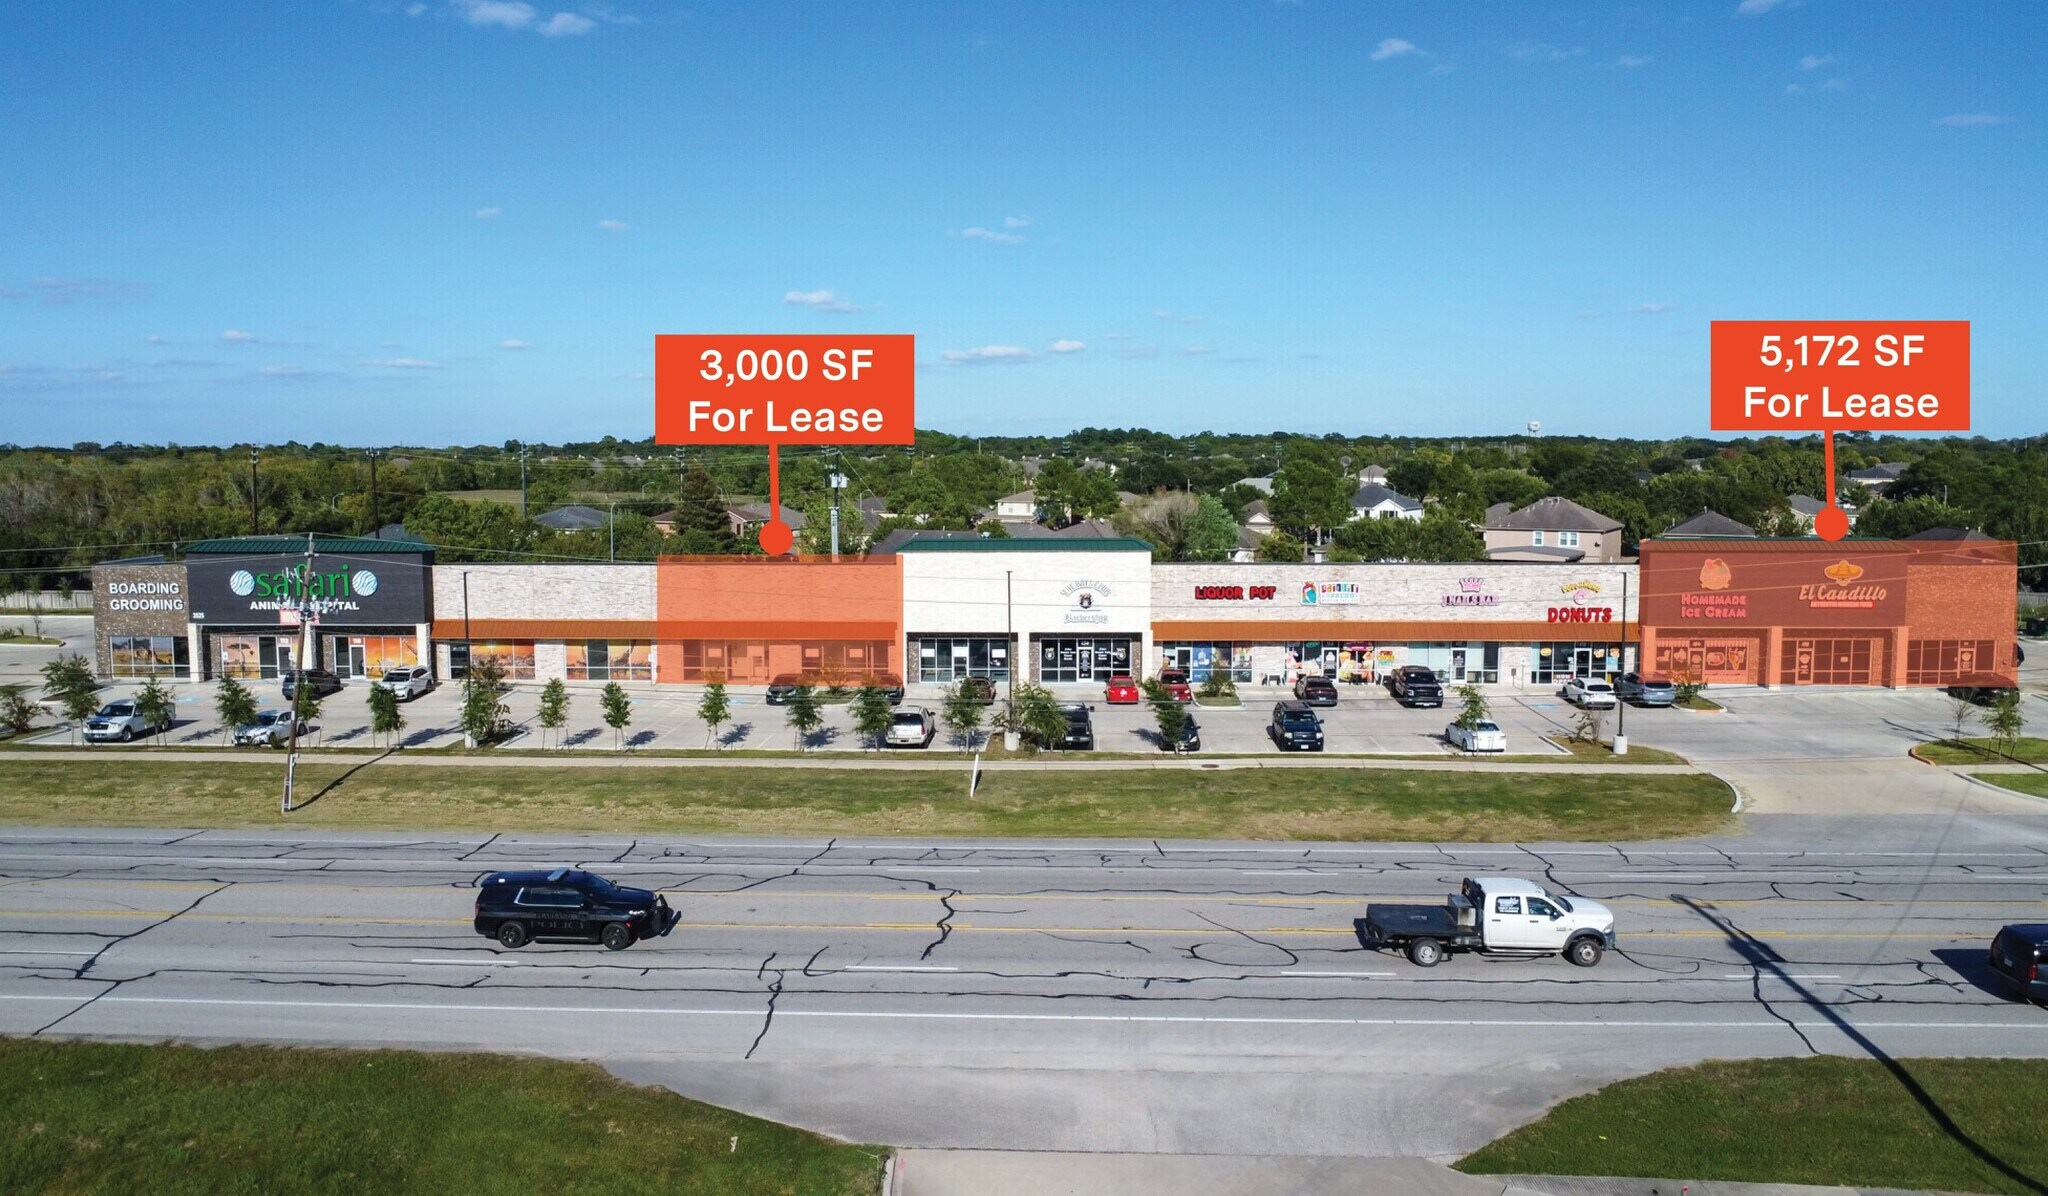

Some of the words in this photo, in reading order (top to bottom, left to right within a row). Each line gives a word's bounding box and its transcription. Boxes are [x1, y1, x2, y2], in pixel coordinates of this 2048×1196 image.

[255, 562, 351, 598] safari
[109, 582, 180, 596] BOARDING
[1195, 587, 1243, 600] LIQUOR
[1250, 587, 1276, 600] POT
[1799, 585, 1816, 600] El
[1817, 585, 1887, 601] Caudillo
[110, 597, 184, 611] GROOMING
[299, 601, 360, 610] PITAL
[1681, 594, 1747, 606] HOMEMADE
[1548, 607, 1612, 624] DONUTS
[1681, 606, 1701, 618] ICE
[1705, 606, 1747, 618] CREAM
[530, 920, 585, 929] POLICE
